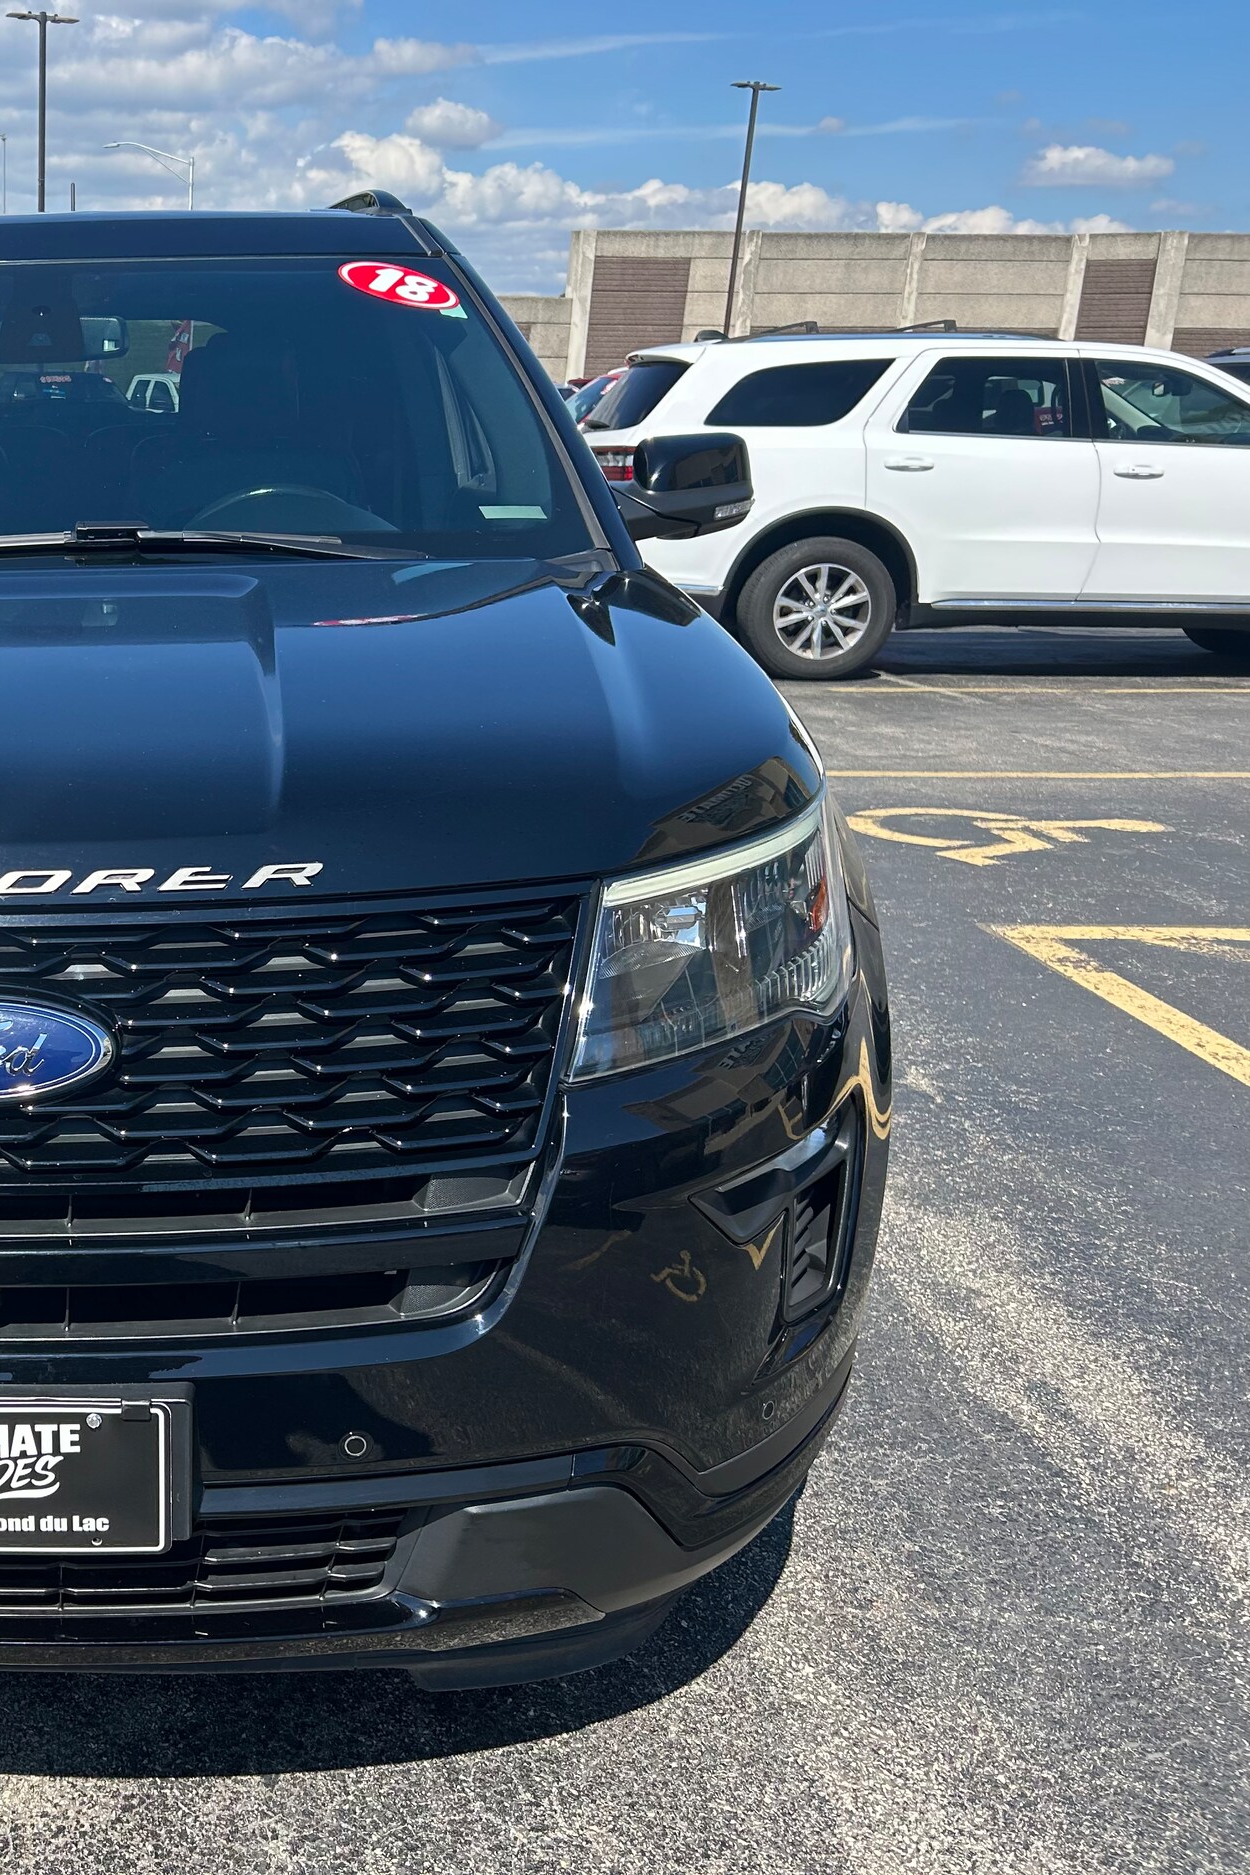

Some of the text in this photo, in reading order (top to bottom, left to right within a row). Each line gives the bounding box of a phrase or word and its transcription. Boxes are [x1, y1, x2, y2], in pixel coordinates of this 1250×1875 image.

[368, 268, 438, 302] 18
[40, 1515, 68, 1532] du
[72, 1515, 110, 1532] Lac
